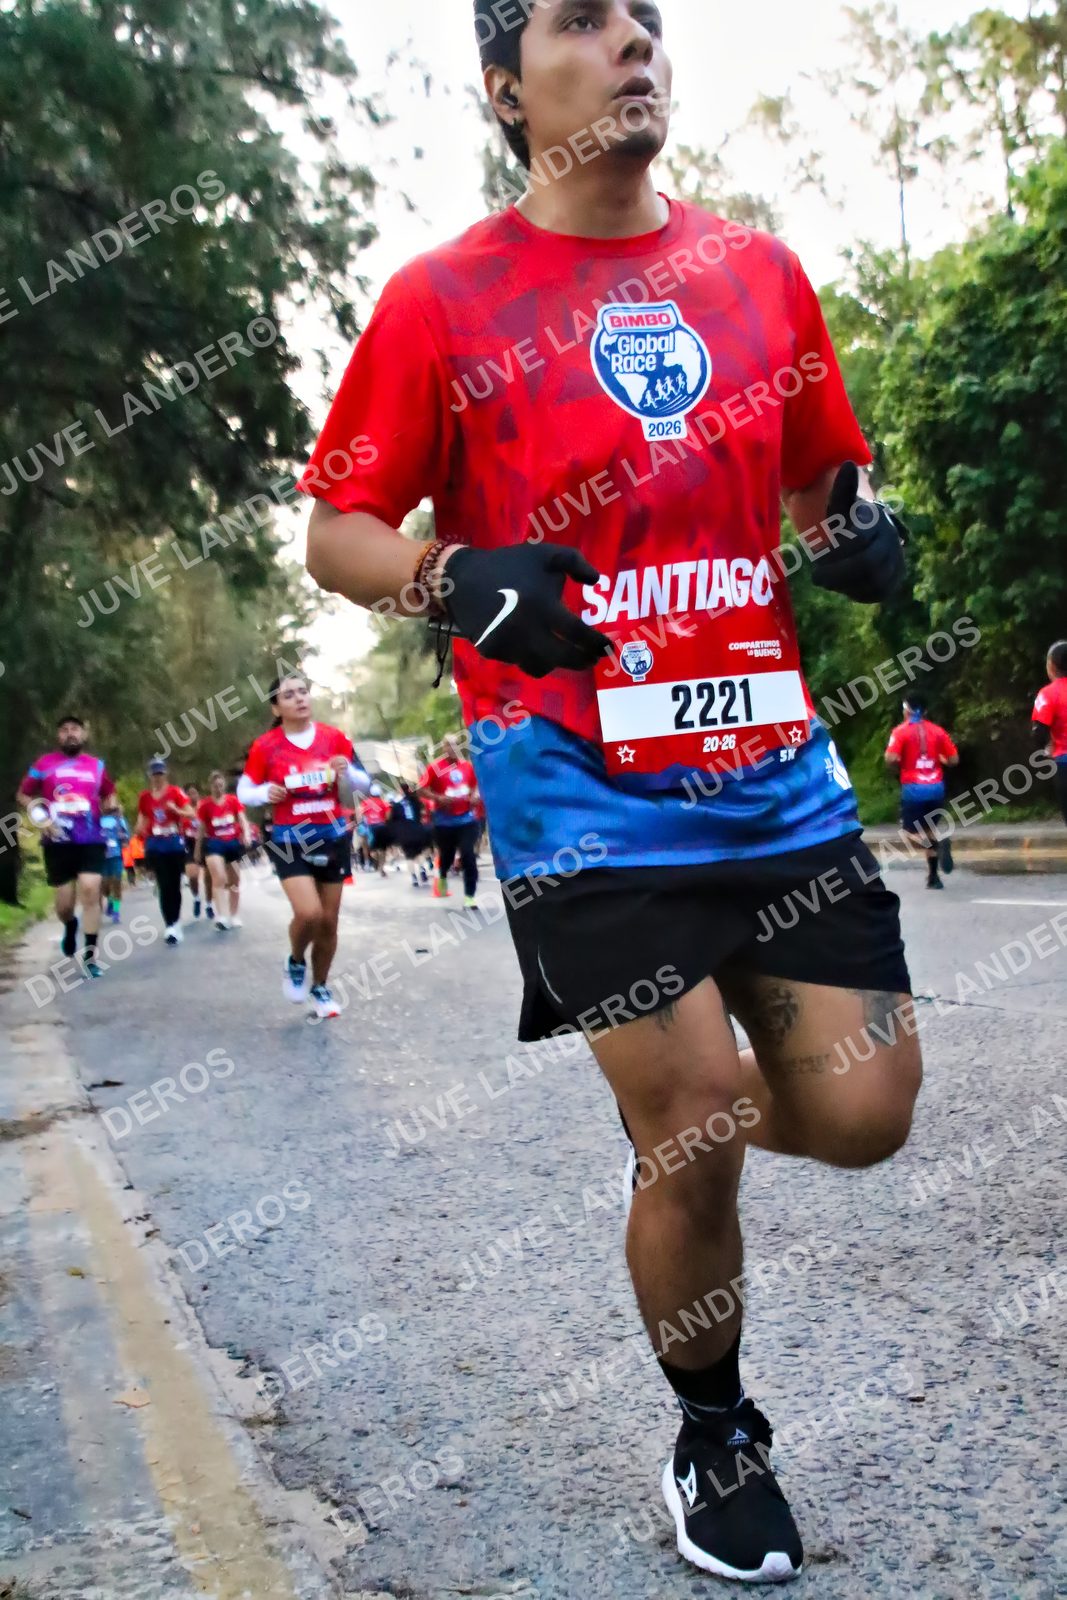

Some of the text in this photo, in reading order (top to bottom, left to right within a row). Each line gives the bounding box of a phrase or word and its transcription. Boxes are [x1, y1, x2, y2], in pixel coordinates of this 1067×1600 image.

[609, 313, 671, 328] BIMBO
[617, 332, 675, 354] Global
[611, 353, 656, 373] Race
[648, 420, 682, 437] 2026
[581, 558, 774, 626] SANTIAGO
[671, 678, 754, 730] 2221
